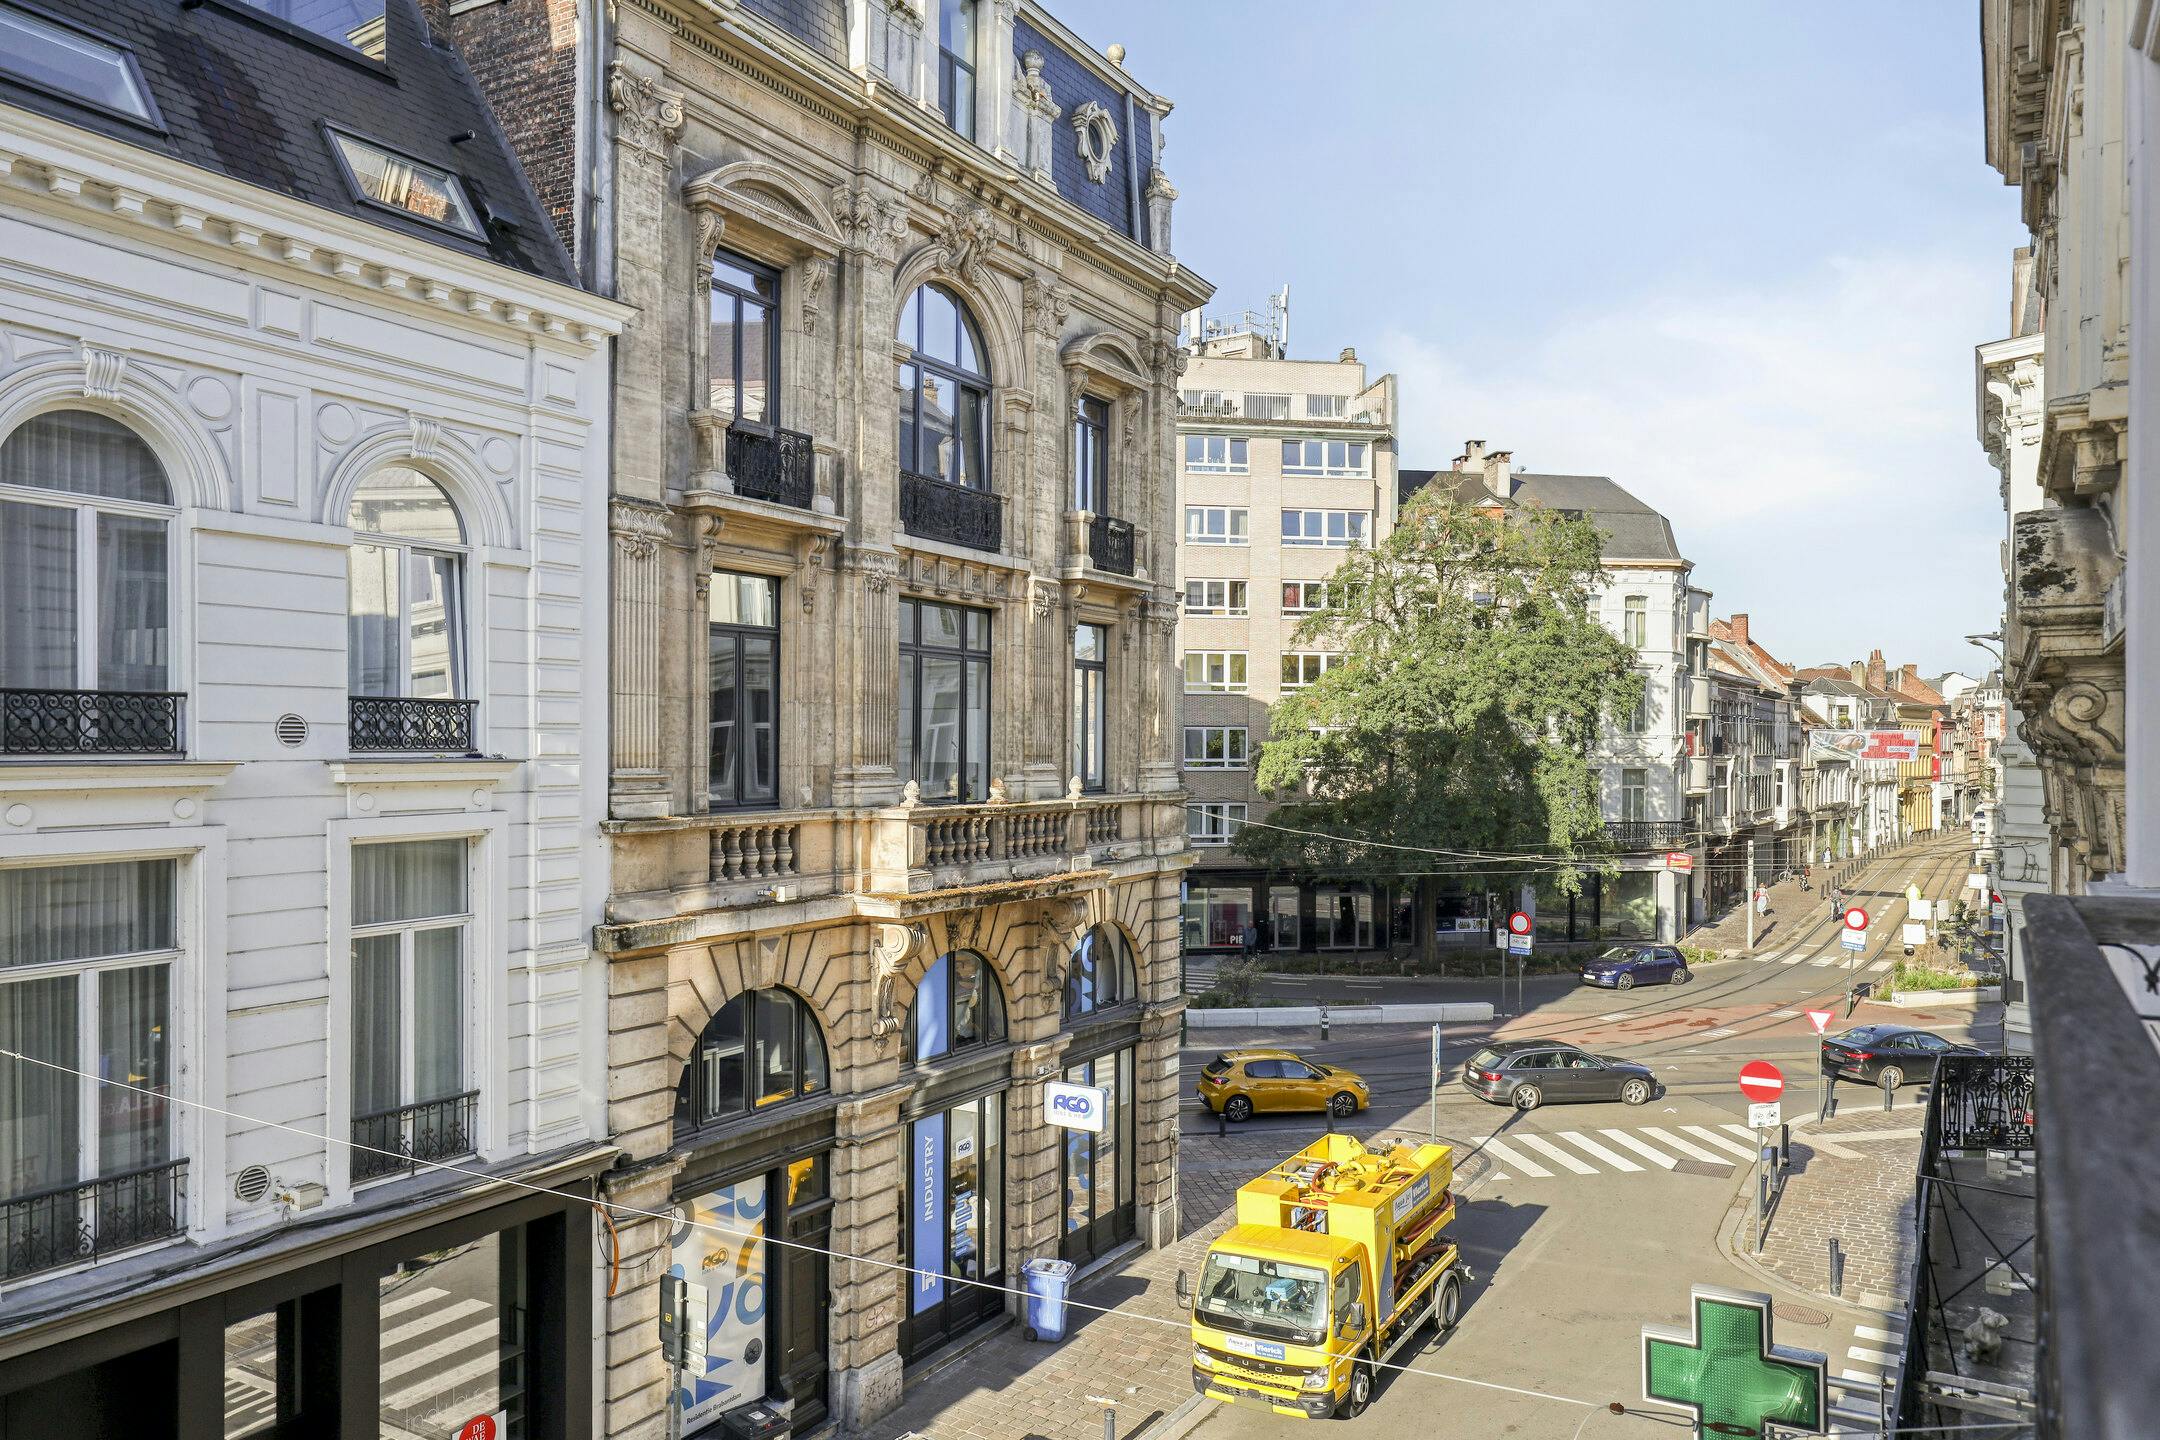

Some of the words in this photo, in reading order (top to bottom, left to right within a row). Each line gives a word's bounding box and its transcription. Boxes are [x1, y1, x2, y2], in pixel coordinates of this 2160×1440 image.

[924, 1136, 934, 1222] INDUSTRY
[1226, 1356, 1283, 1373] FUSO
[686, 1407, 712, 1425] Residentie
[472, 1420, 485, 1434] DE
